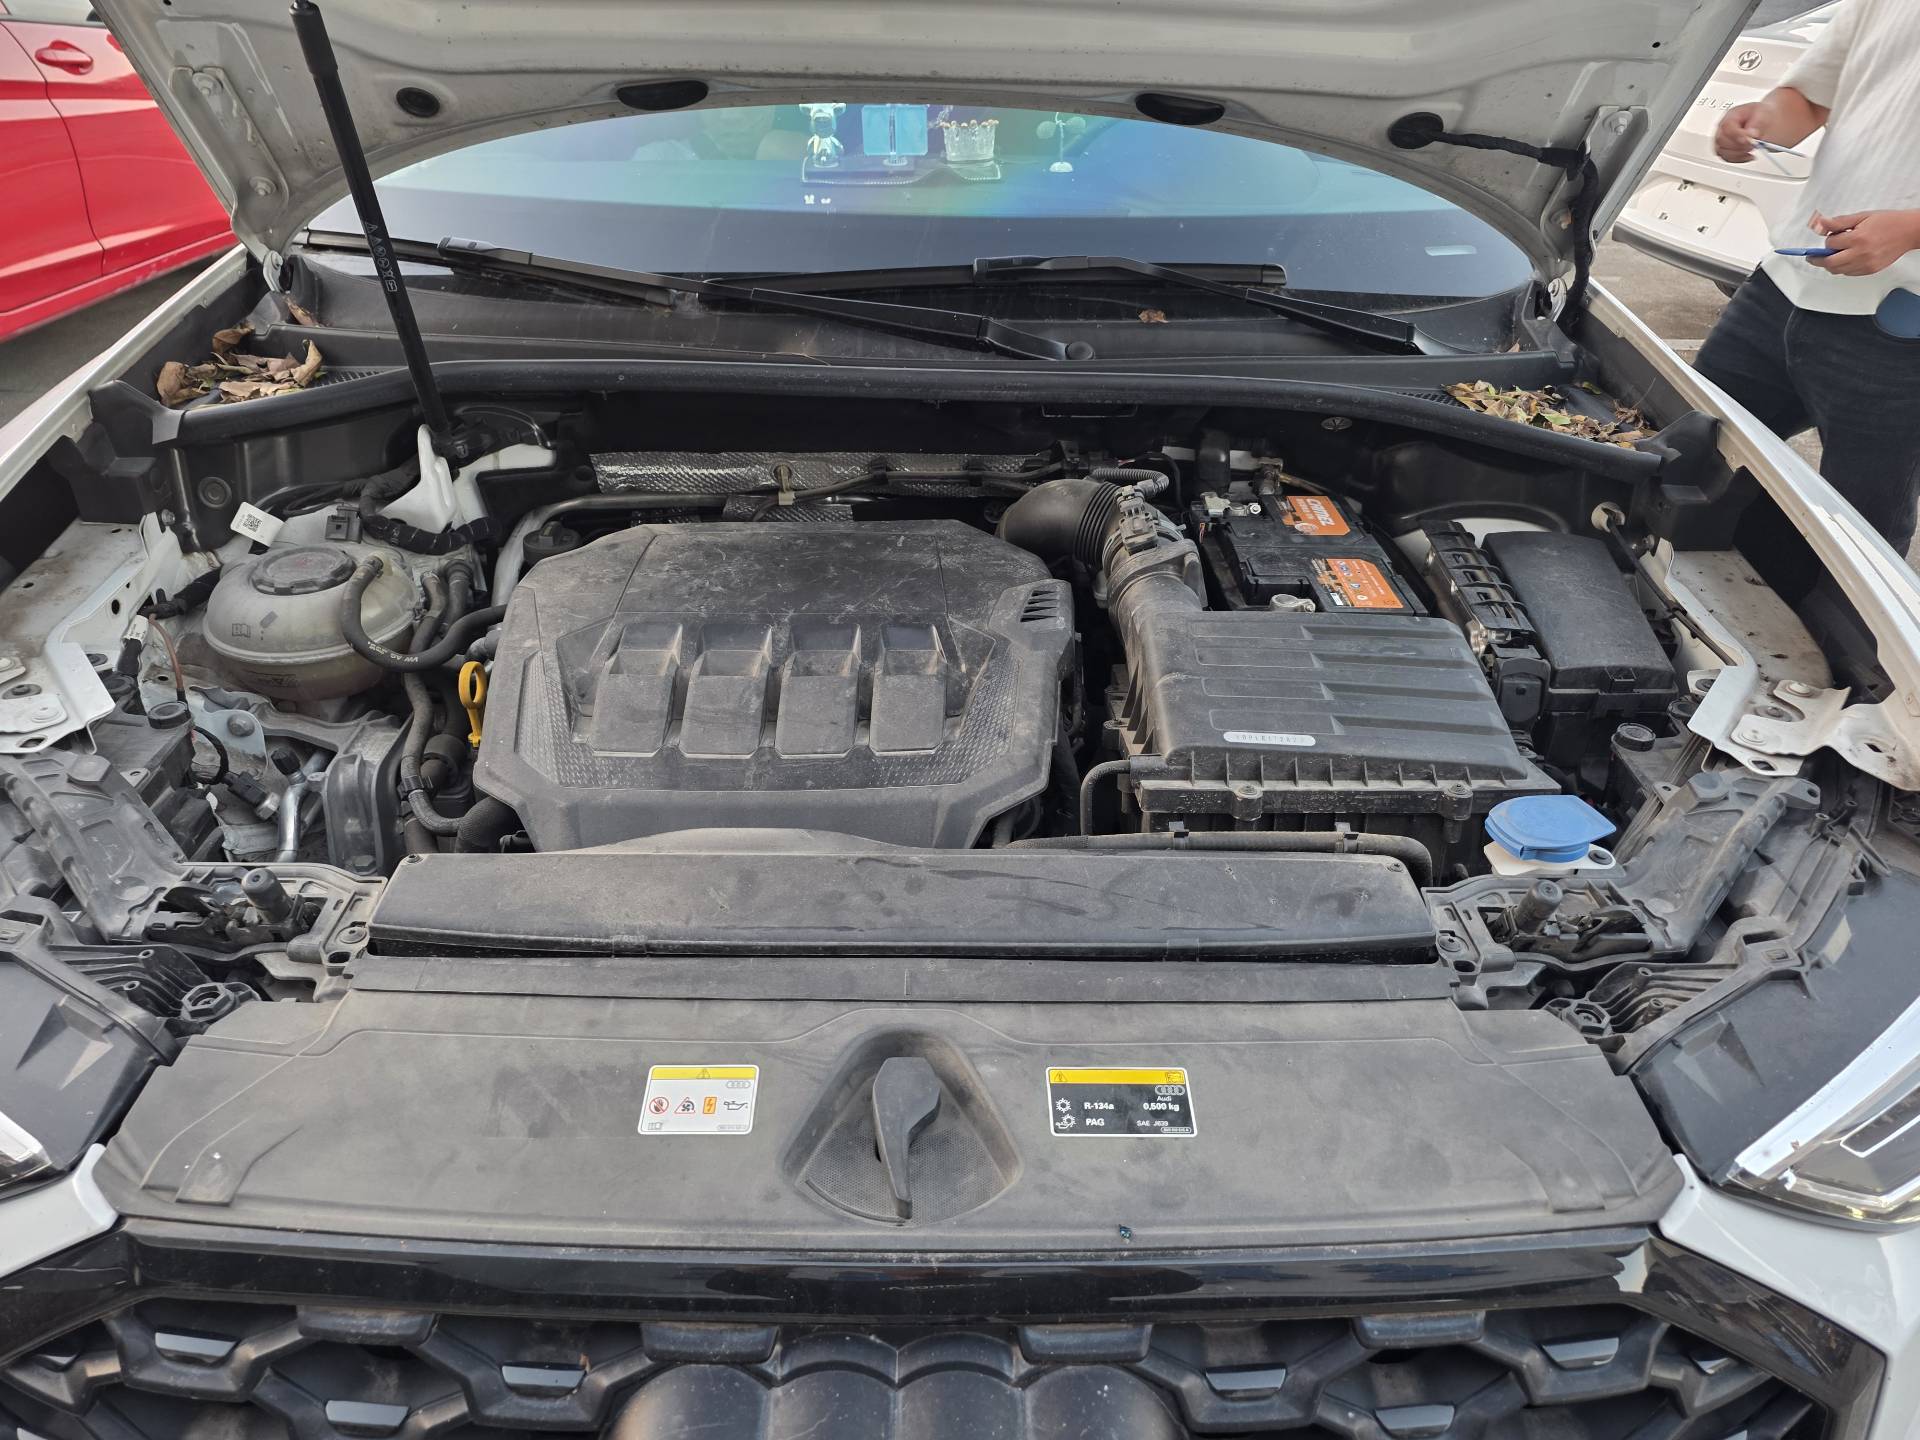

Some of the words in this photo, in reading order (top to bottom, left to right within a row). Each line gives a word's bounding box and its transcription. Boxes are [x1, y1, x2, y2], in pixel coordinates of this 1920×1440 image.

[1083, 1101, 1115, 1110] R-134a
[1168, 1102, 1180, 1112] kg
[1085, 1118, 1105, 1126] PAG
